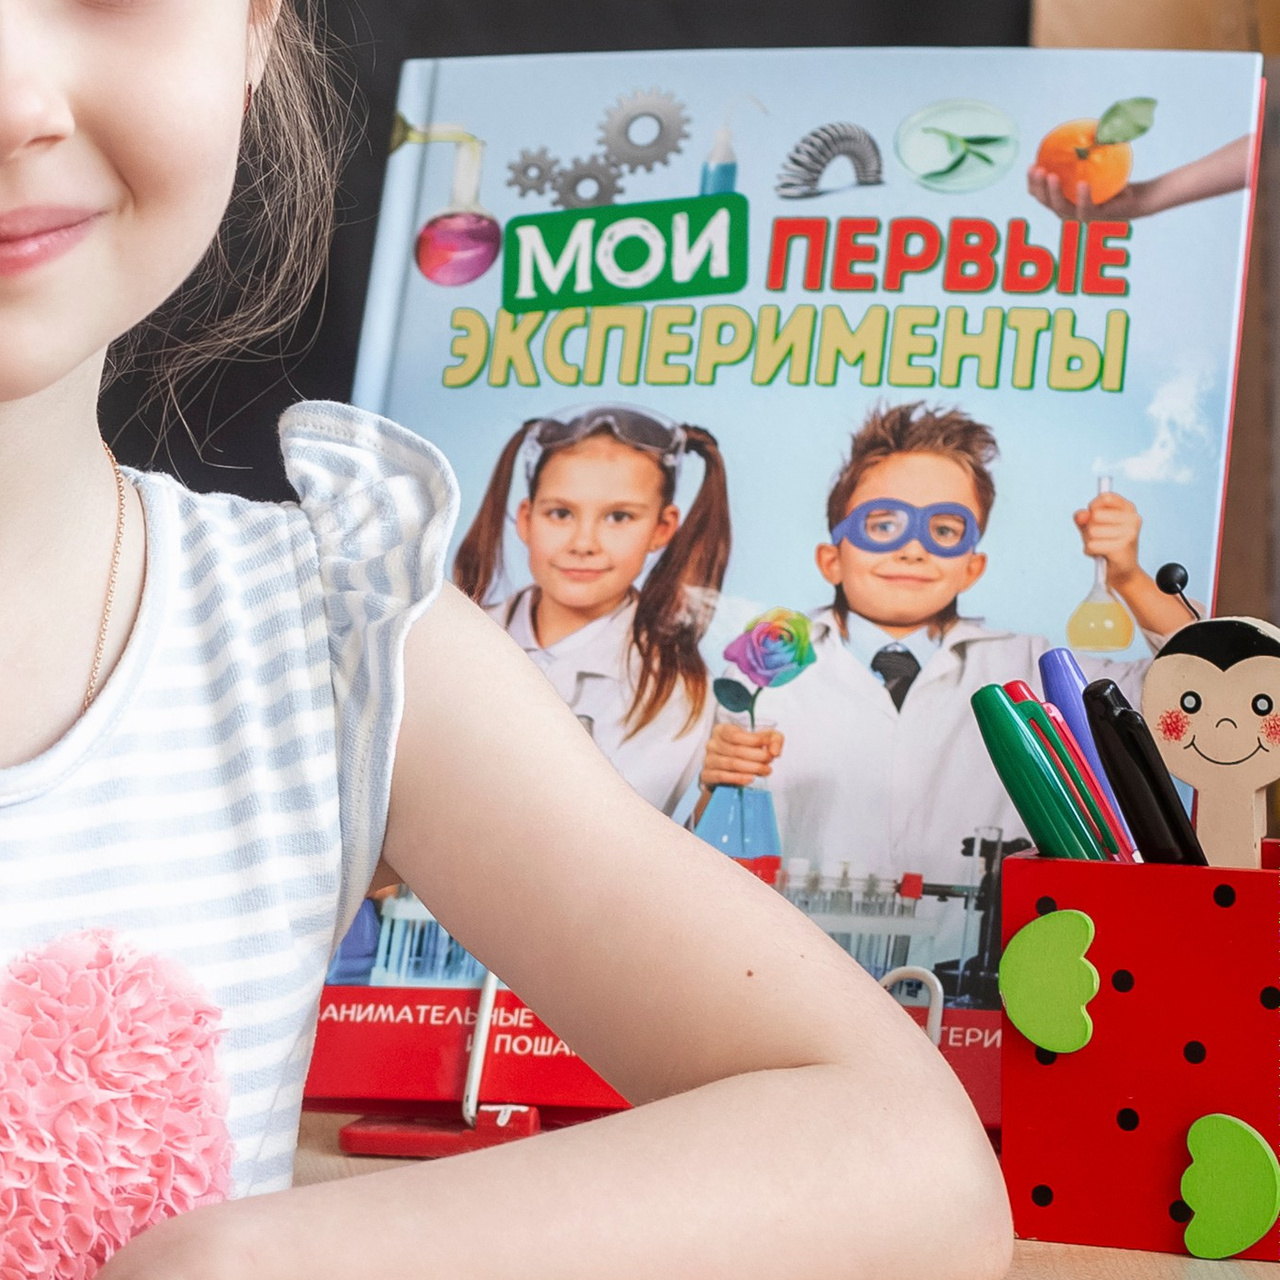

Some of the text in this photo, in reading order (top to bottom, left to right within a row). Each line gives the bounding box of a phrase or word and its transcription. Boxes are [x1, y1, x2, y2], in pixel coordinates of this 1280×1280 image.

[515, 208, 1131, 299] МОИ ПЕРВЫЕ
[443, 304, 1130, 392] ЭКСПЕРИМЕНТЫ
[320, 1003, 534, 1028] АНИМАТЕЛЬНЫЕ
[494, 1034, 577, 1056] ПОША
